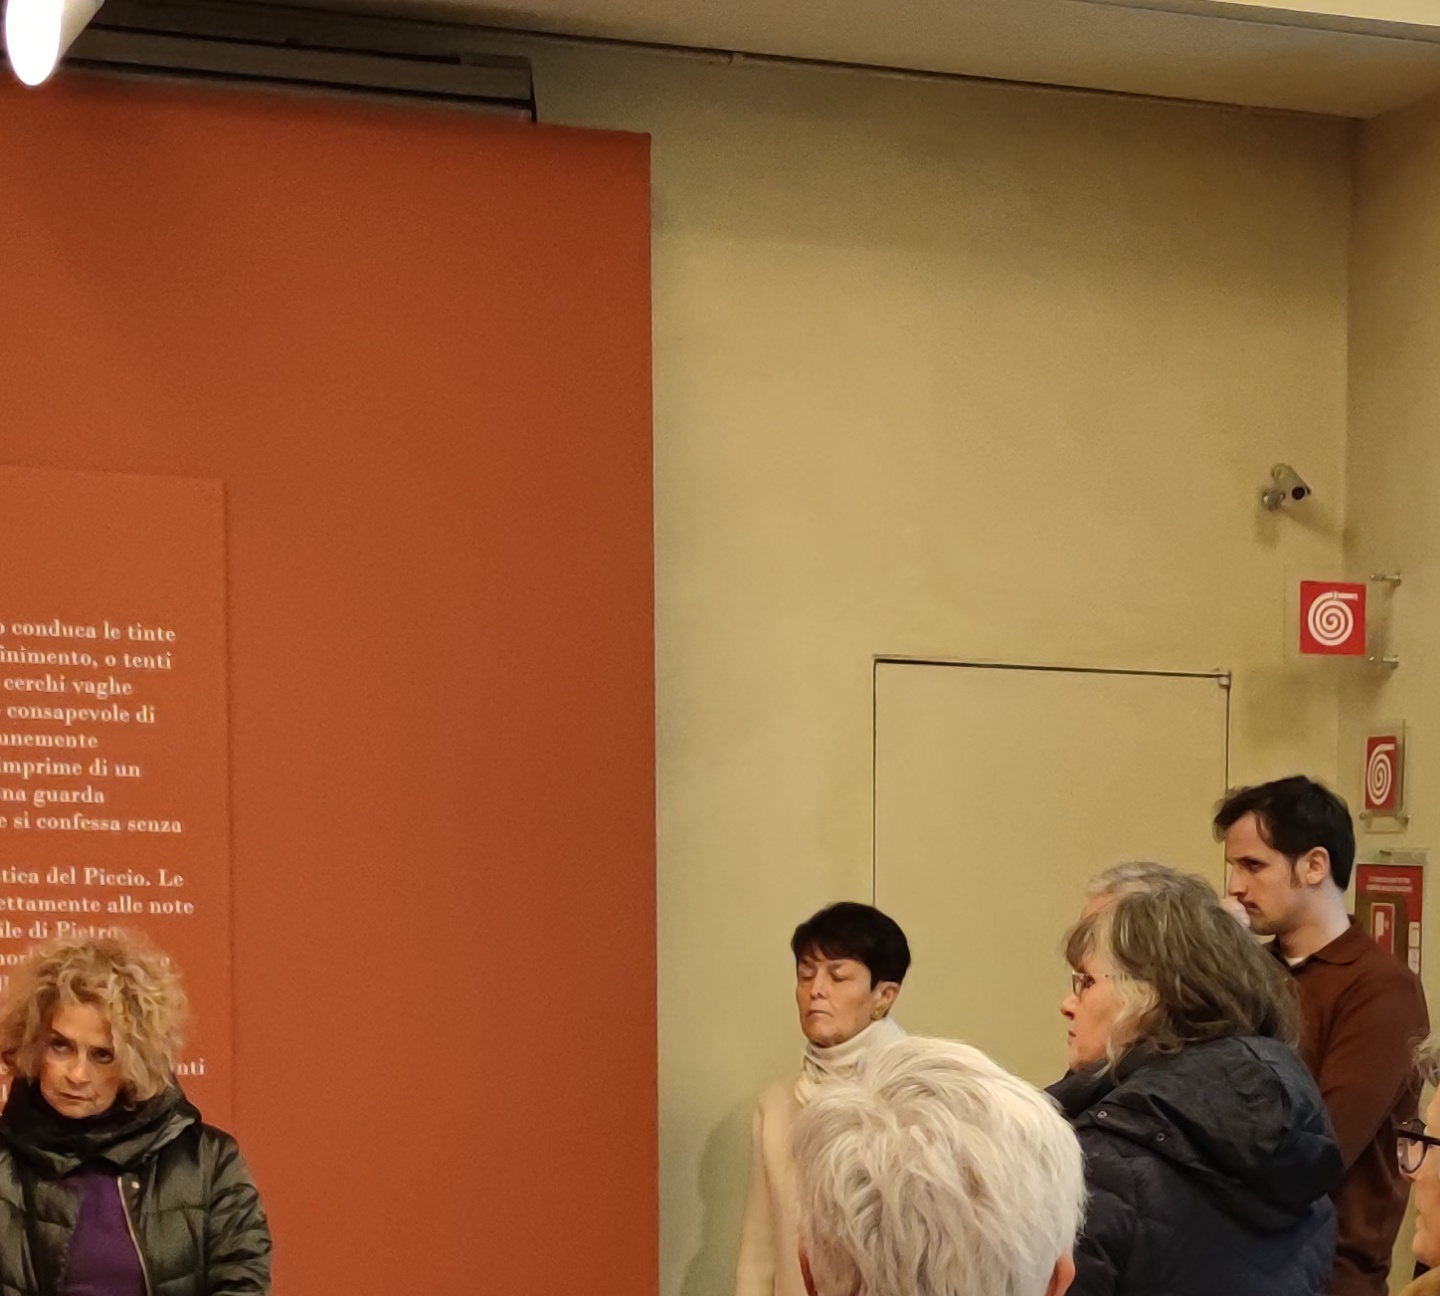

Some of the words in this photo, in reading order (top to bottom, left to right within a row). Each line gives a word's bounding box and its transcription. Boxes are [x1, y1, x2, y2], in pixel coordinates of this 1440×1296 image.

[12, 618, 96, 639] conduca
[104, 621, 120, 640] le
[128, 623, 175, 642] tinte
[105, 654, 116, 667] o
[123, 651, 171, 670] tenti
[4, 673, 65, 693] cerchi
[72, 676, 132, 699] vaghe
[7, 704, 130, 726] consapevole
[136, 704, 155, 724] di
[89, 757, 108, 776] di
[115, 764, 140, 778] un
[34, 785, 105, 808] guarda
[14, 812, 30, 830] si
[36, 812, 121, 832] confessa
[128, 819, 182, 833] senza
[46, 865, 76, 885] del
[85, 866, 150, 887] Piccio.
[159, 868, 183, 887] Le
[107, 895, 142, 914] alle
[150, 899, 194, 915] note
[29, 920, 47, 938] di
